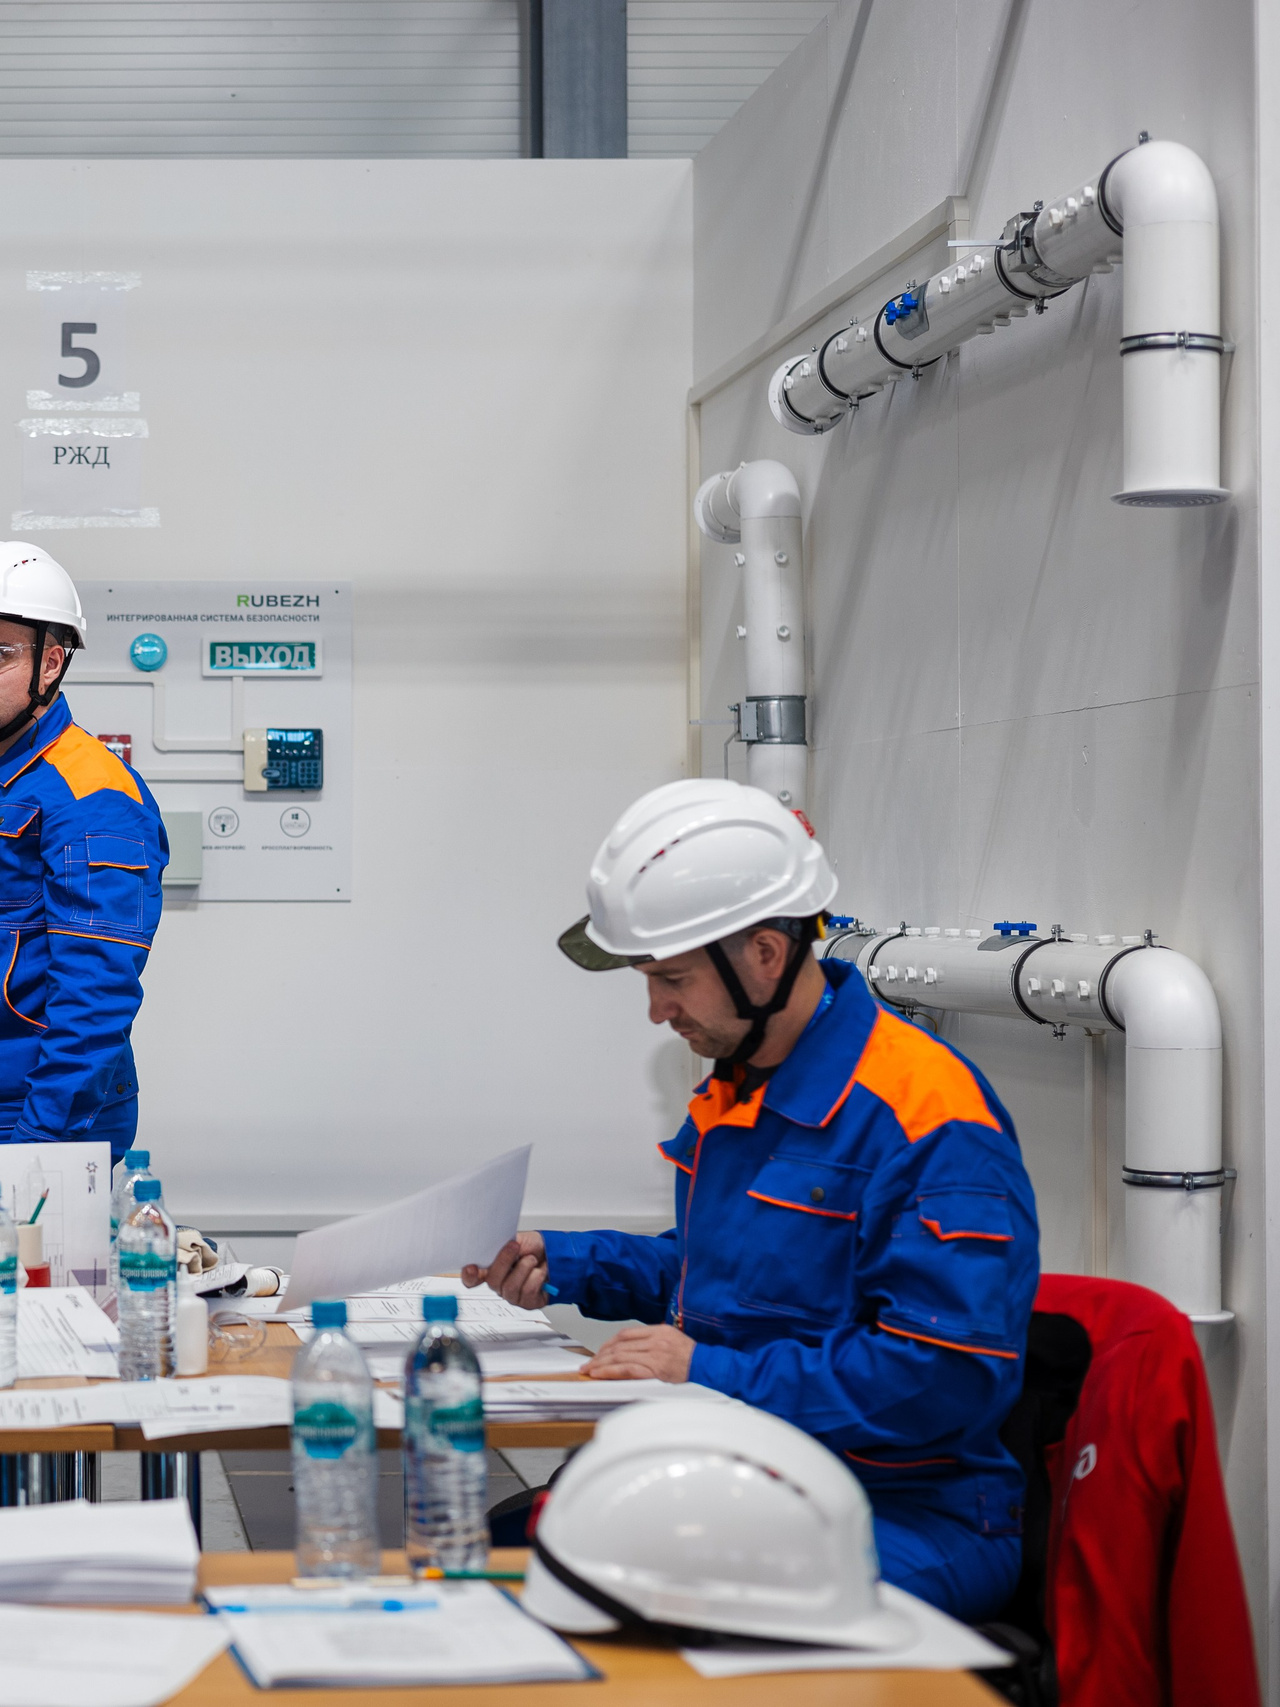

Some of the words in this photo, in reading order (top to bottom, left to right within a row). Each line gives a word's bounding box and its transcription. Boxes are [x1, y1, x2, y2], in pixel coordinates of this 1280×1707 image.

[57, 322, 101, 389] 5
[52, 446, 111, 469] РЖД
[236, 594, 320, 608] RUBEZH
[106, 614, 199, 623] ИНТЕГРИРОВАННАЯ
[200, 614, 245, 623] СИСТЕМА
[246, 614, 320, 623] БЕЗОПАСНОСТИ
[214, 645, 312, 669] ВЫХОД
